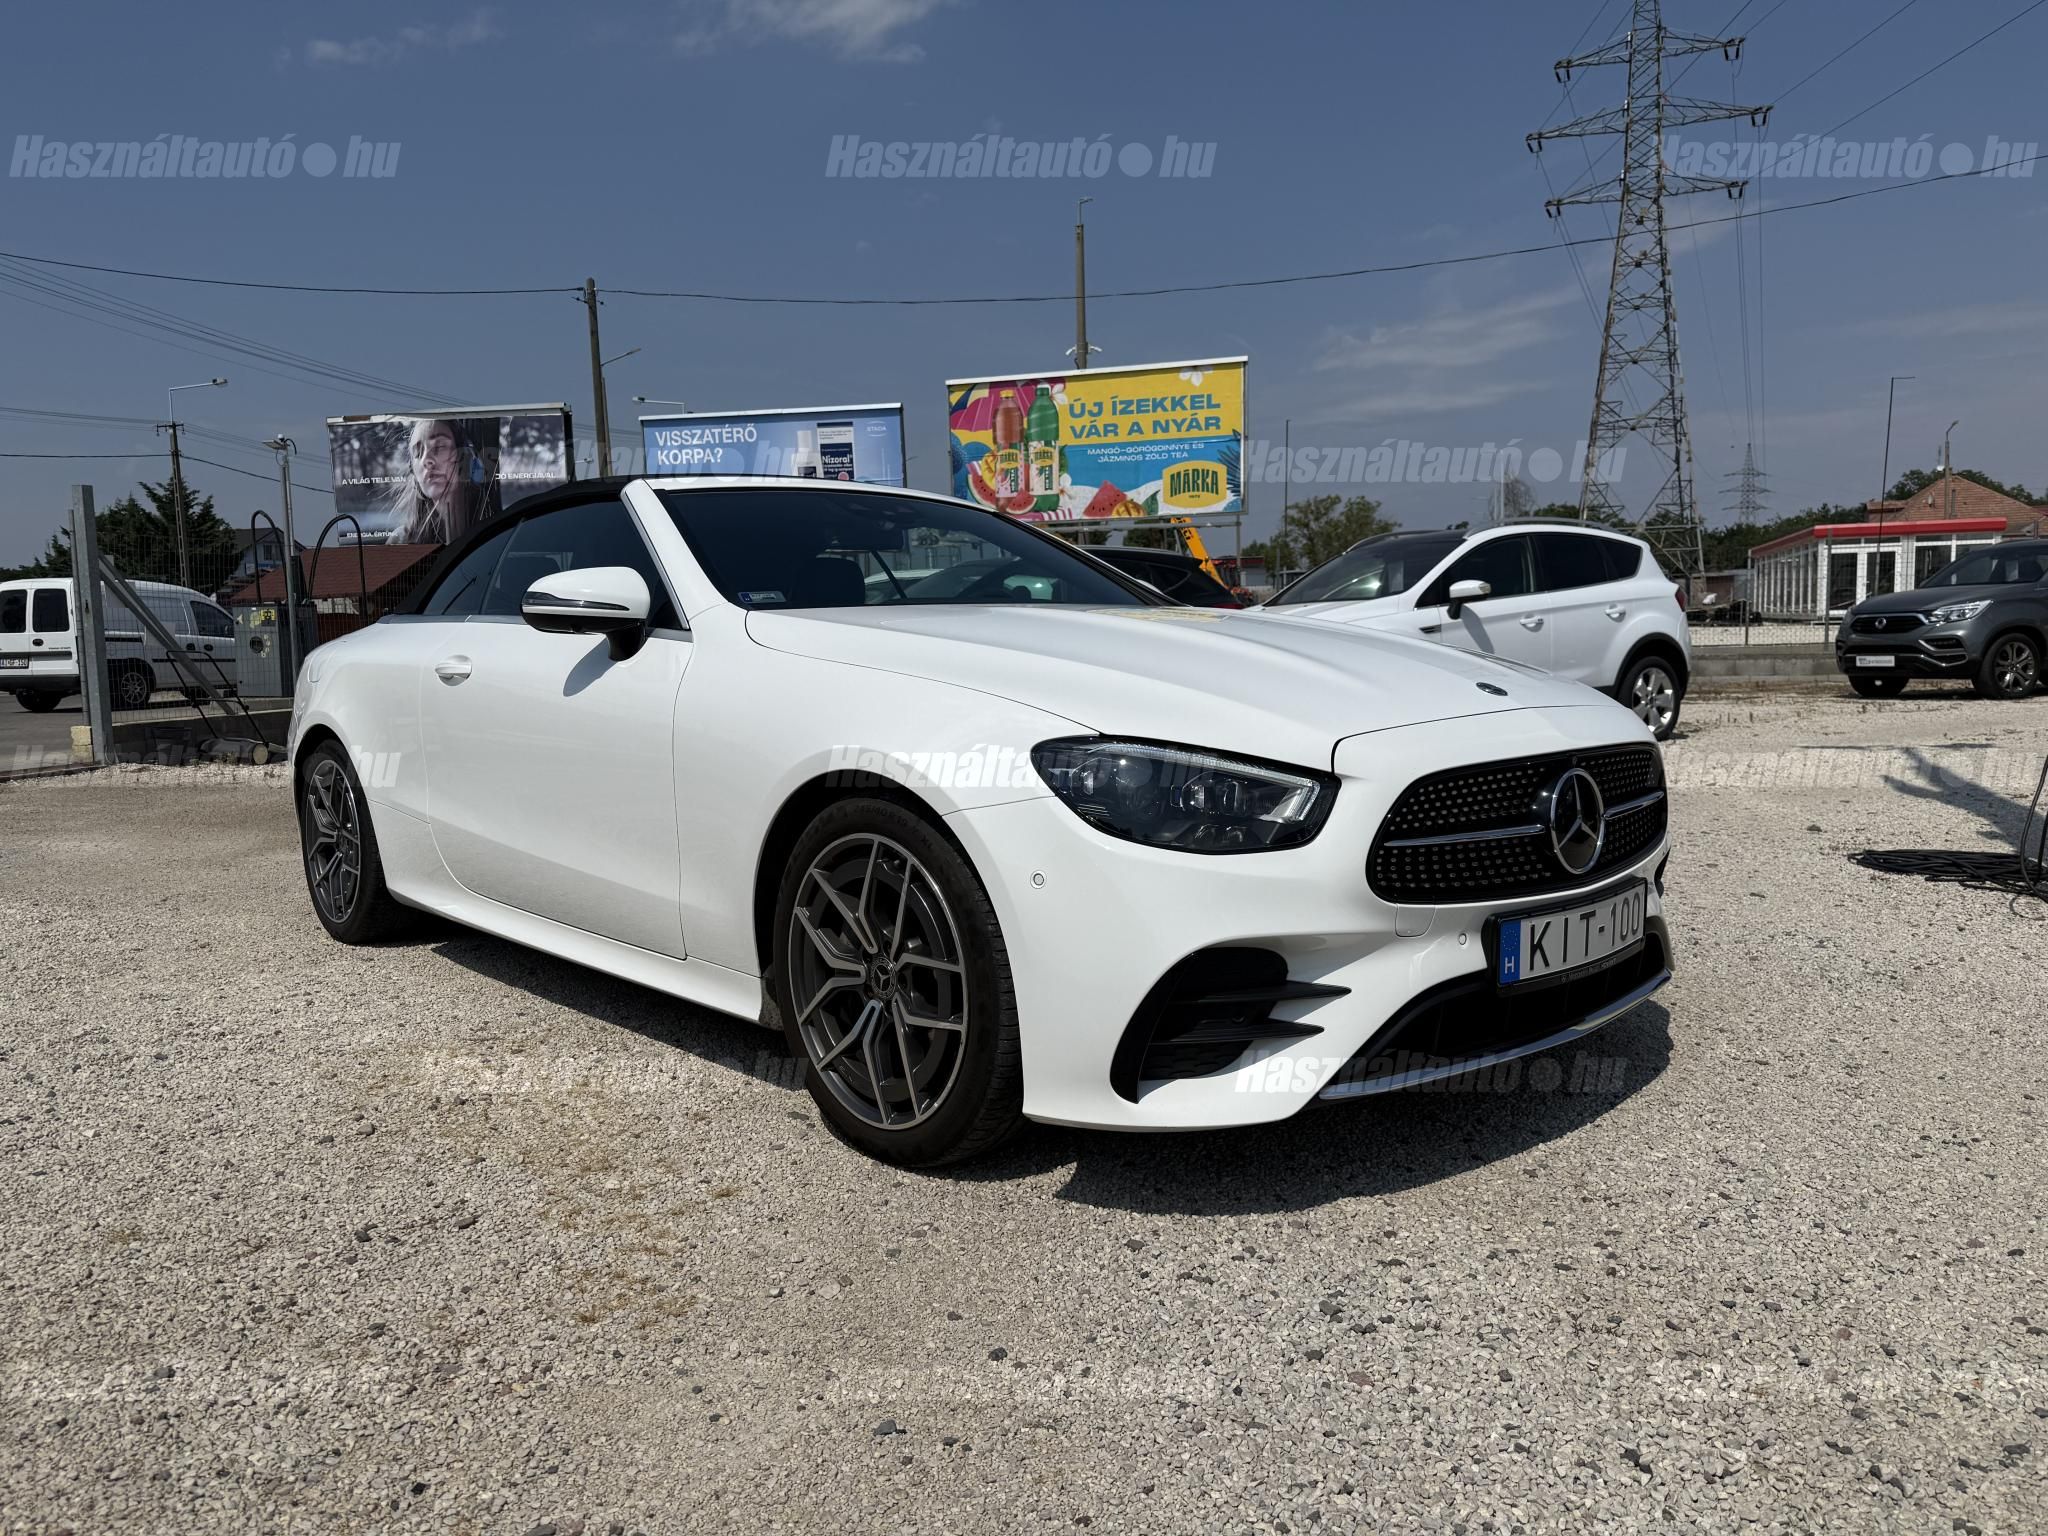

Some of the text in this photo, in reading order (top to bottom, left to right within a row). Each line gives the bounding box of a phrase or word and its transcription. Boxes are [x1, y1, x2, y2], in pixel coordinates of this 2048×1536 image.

[1069, 394, 1221, 419] ÚJ ÍZEKKEL
[655, 423, 758, 447] VISSZATÉRŐ
[1070, 413, 1221, 440] VÁR A NYÁR
[657, 447, 723, 466] KORPA?
[1170, 450, 1189, 459] TEA
[1529, 892, 1641, 971] KIT-100
[1504, 956, 1515, 975] H
